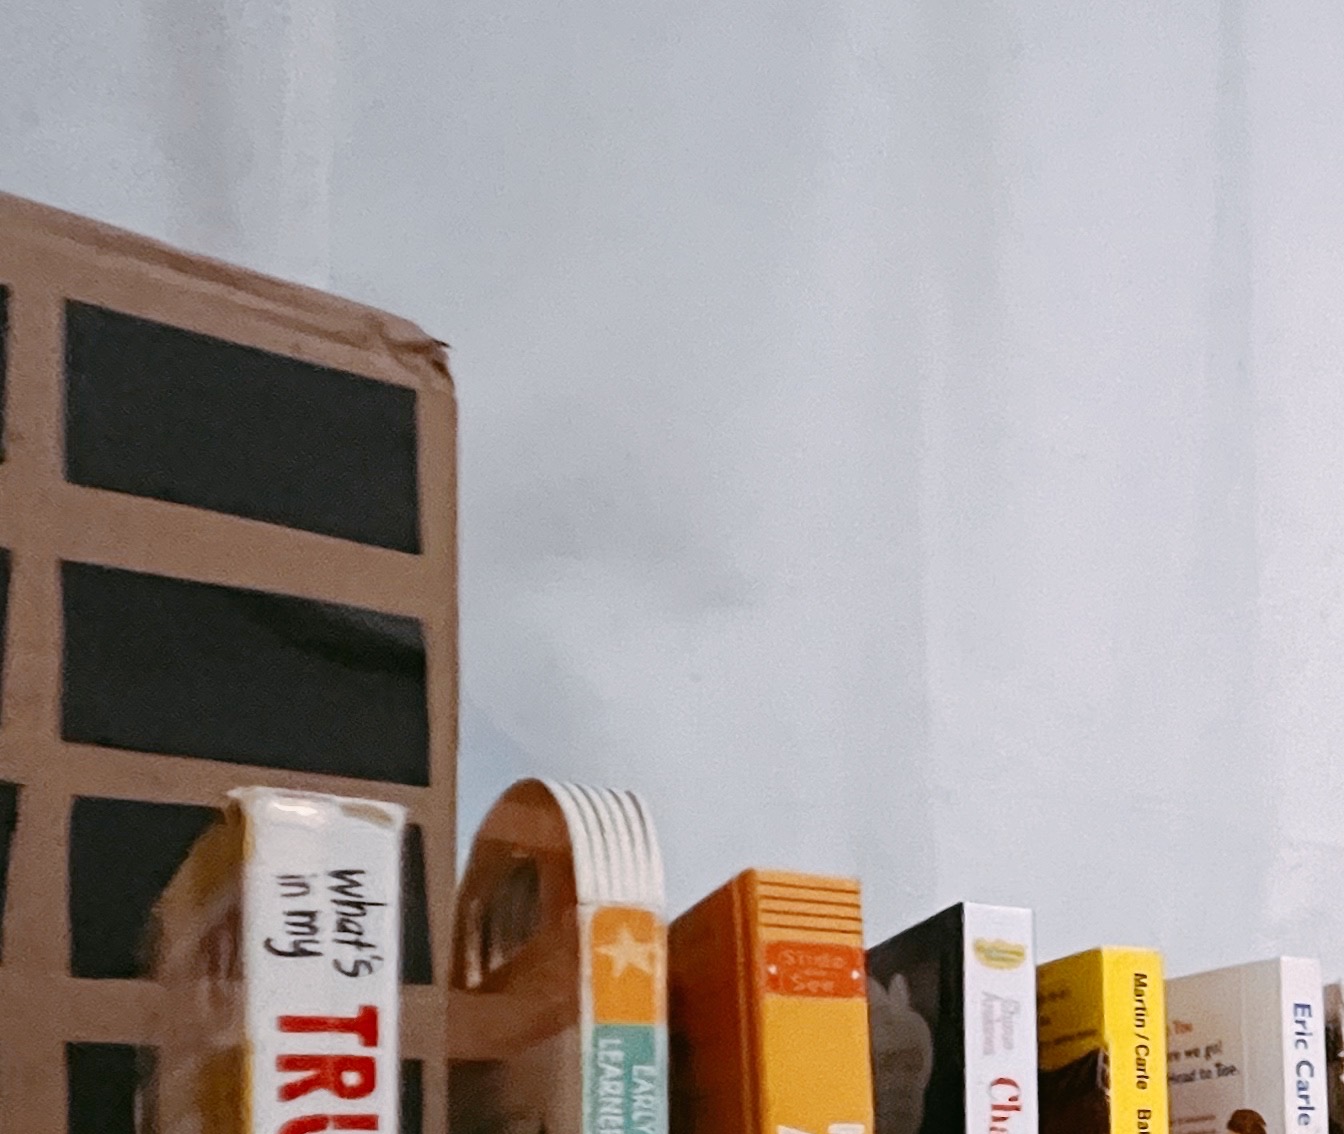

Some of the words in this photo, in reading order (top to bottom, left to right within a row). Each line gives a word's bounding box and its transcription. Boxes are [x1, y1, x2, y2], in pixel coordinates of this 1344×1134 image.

[278, 873, 311, 898] in
[264, 908, 323, 959] my
[326, 868, 386, 979] what's
[1132, 971, 1149, 1030] Martin
[1292, 1001, 1313, 1050] Eric
[1134, 1043, 1151, 1092] Carle
[1293, 1058, 1315, 1127] Carle
